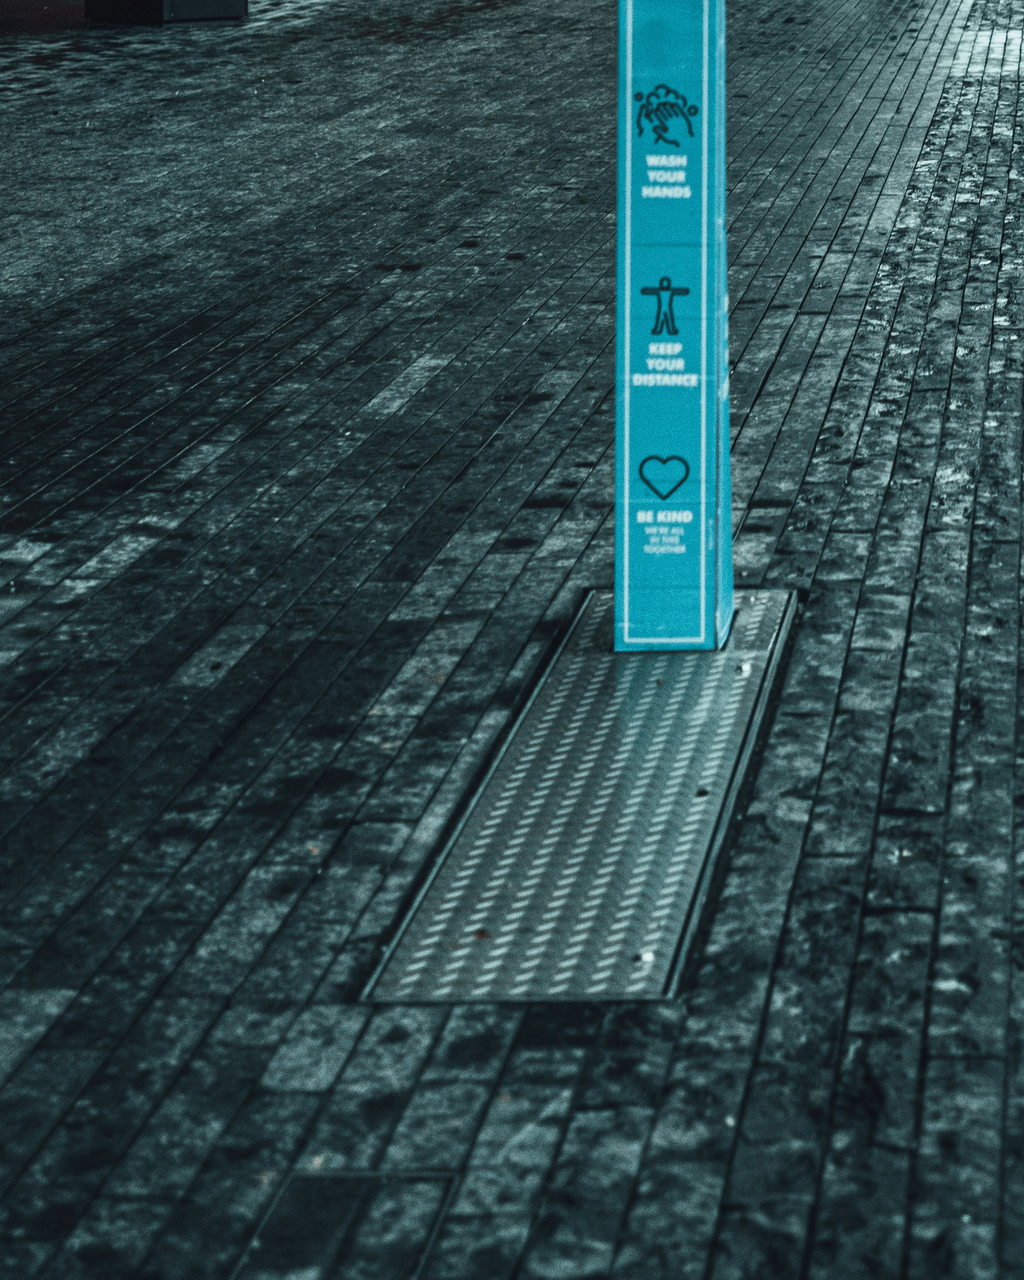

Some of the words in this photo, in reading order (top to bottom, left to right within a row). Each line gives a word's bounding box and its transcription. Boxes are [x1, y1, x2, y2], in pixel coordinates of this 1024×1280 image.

[645, 154, 688, 167] WASH
[647, 170, 687, 183] YOUR
[641, 185, 692, 199] HANDS
[648, 342, 683, 355] KEEP
[645, 357, 685, 371] YOUR
[632, 373, 699, 387] DISTANCE
[636, 510, 654, 523] BE
[656, 510, 694, 523] KIND
